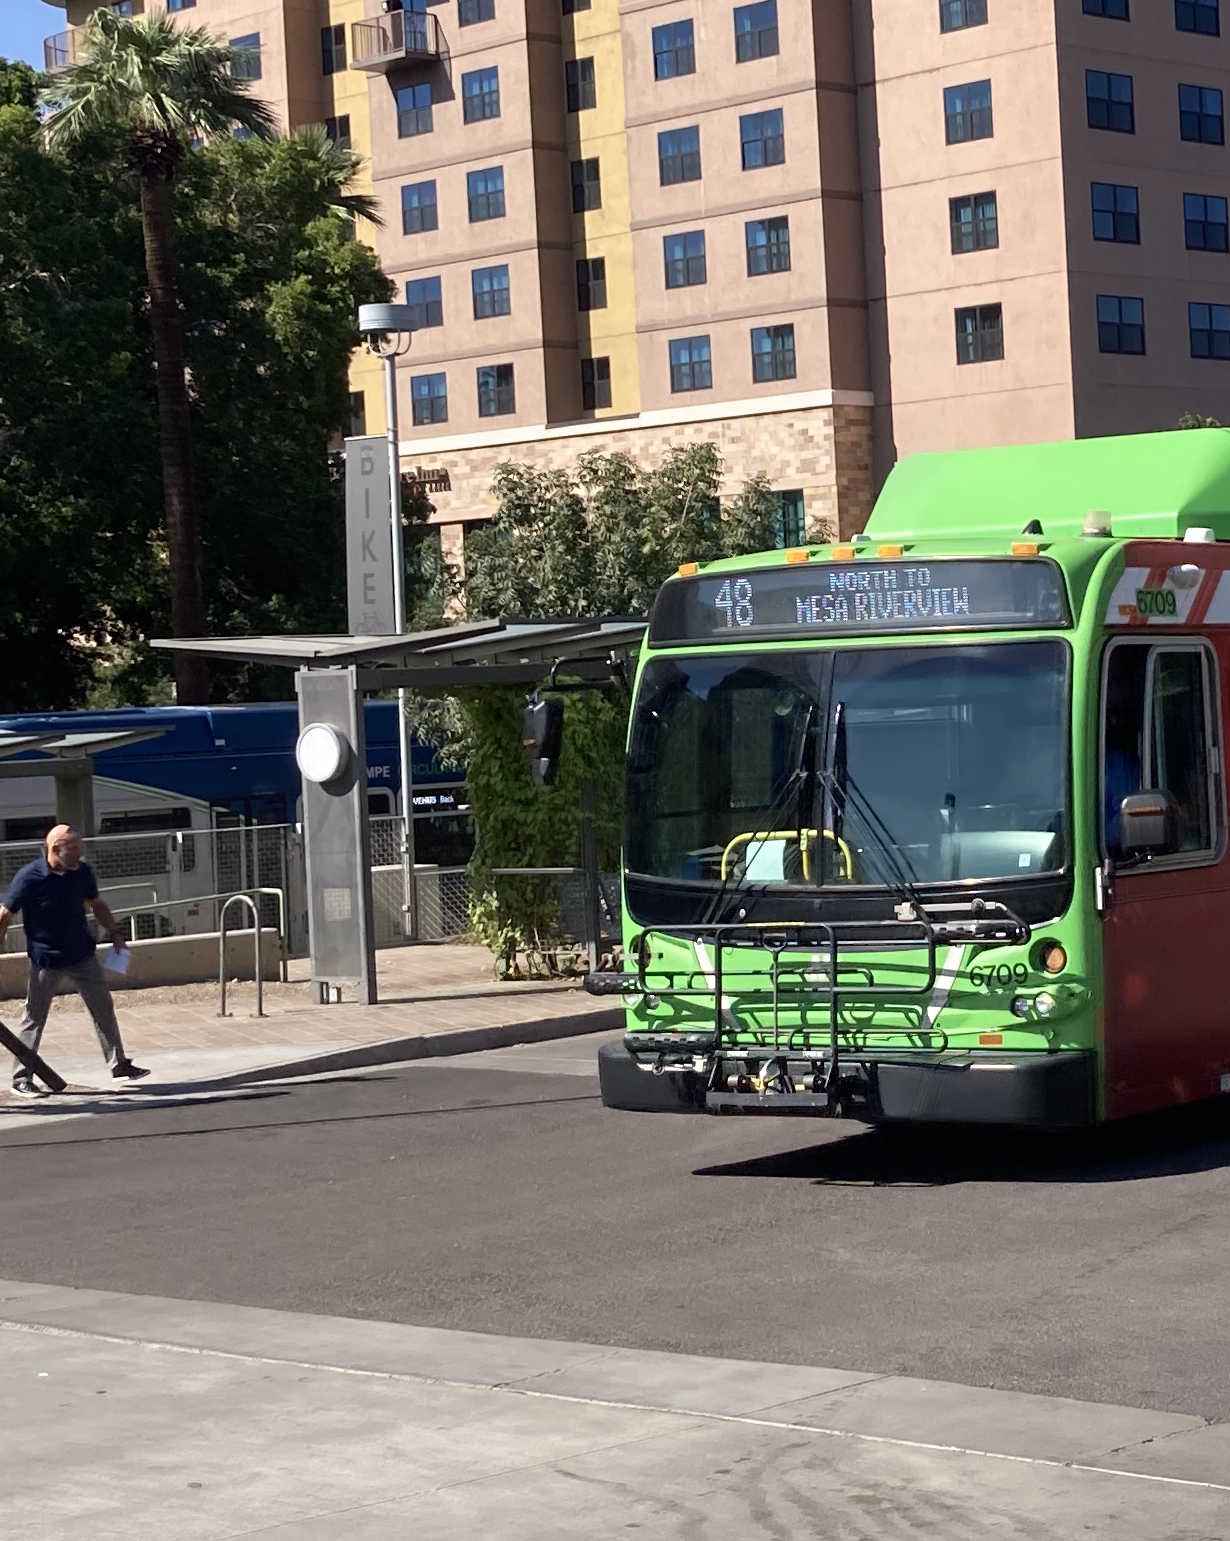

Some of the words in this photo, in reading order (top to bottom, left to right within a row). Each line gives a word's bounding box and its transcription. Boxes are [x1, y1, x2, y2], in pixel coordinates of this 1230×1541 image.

[360, 445, 378, 605] BIKE
[829, 570, 897, 592] NORTH
[905, 567, 931, 588] TO
[796, 593, 848, 624] MESA
[855, 586, 969, 621] RIVERVIEW
[1136, 589, 1176, 616] 6709
[969, 962, 1028, 987] 6709
